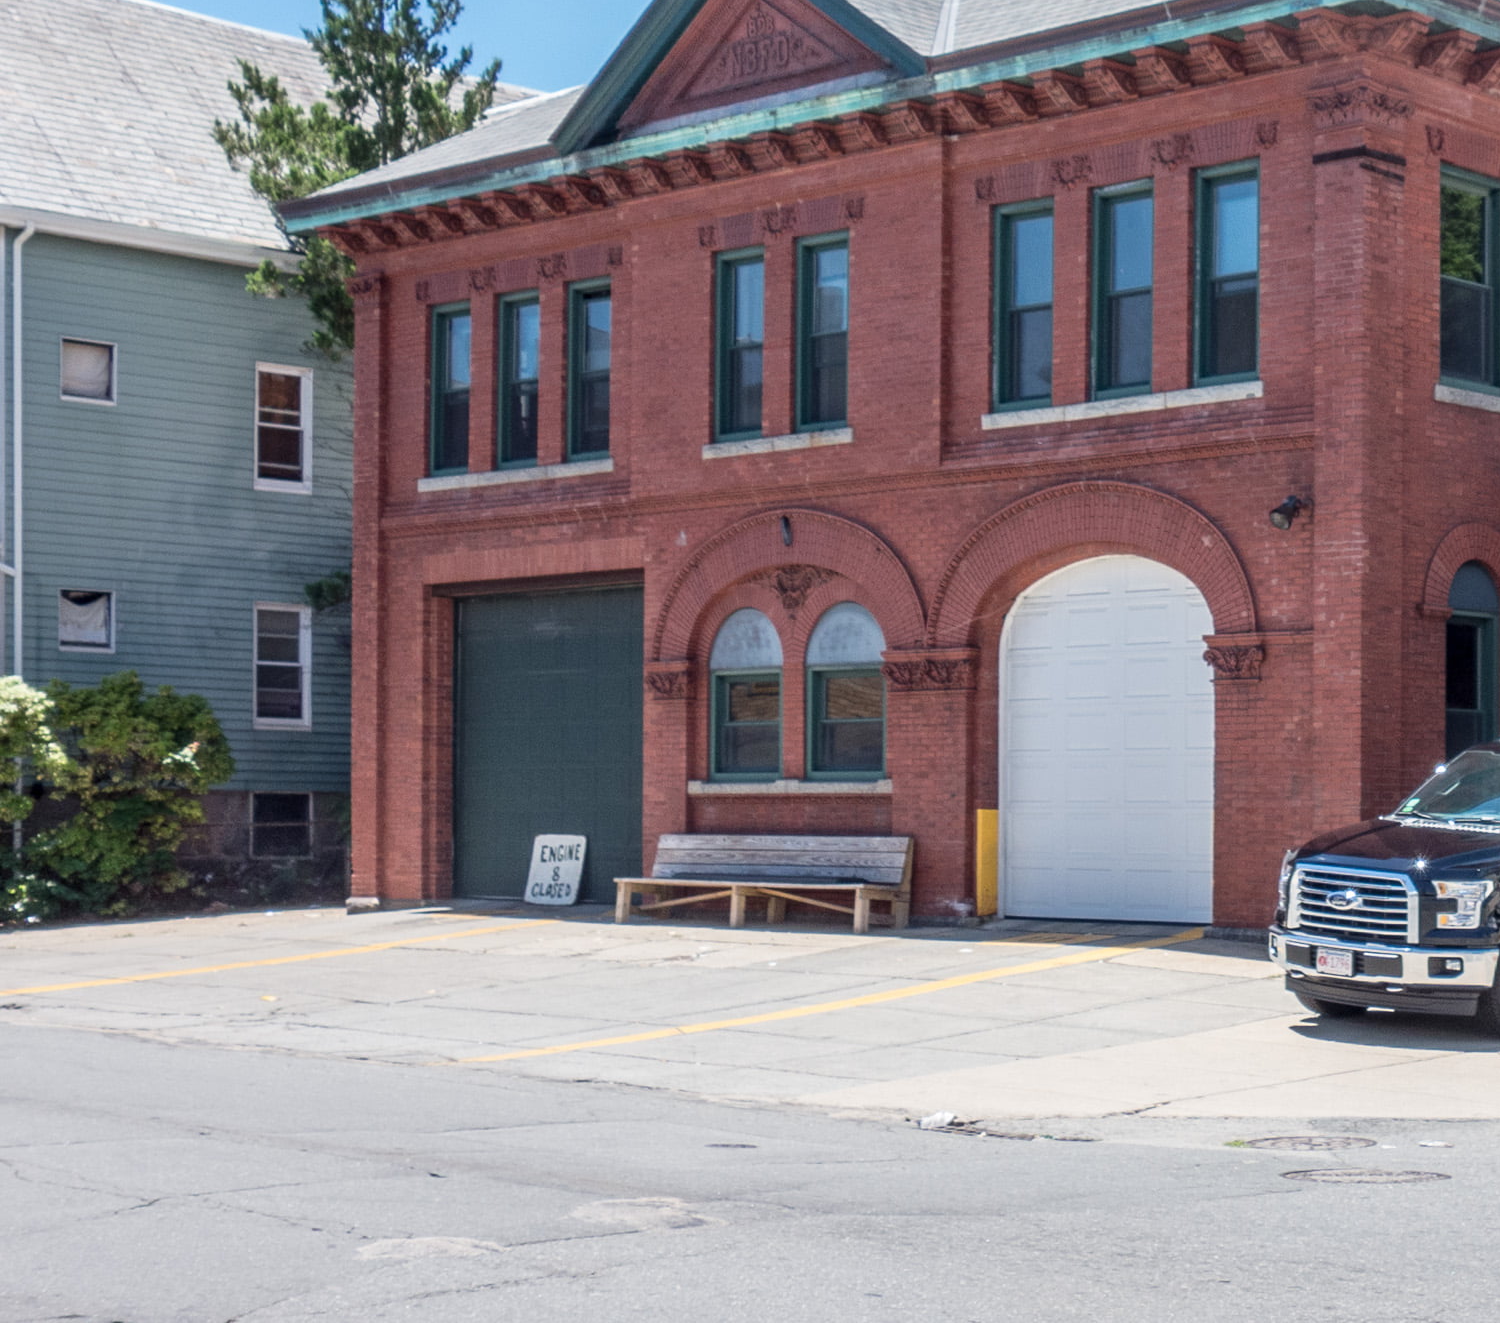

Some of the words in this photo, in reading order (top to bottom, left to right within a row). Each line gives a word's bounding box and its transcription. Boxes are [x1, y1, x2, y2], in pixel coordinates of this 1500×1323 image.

[540, 844, 581, 863] ENGINE
[552, 866, 560, 882] 8
[531, 882, 572, 899] CLOSED
